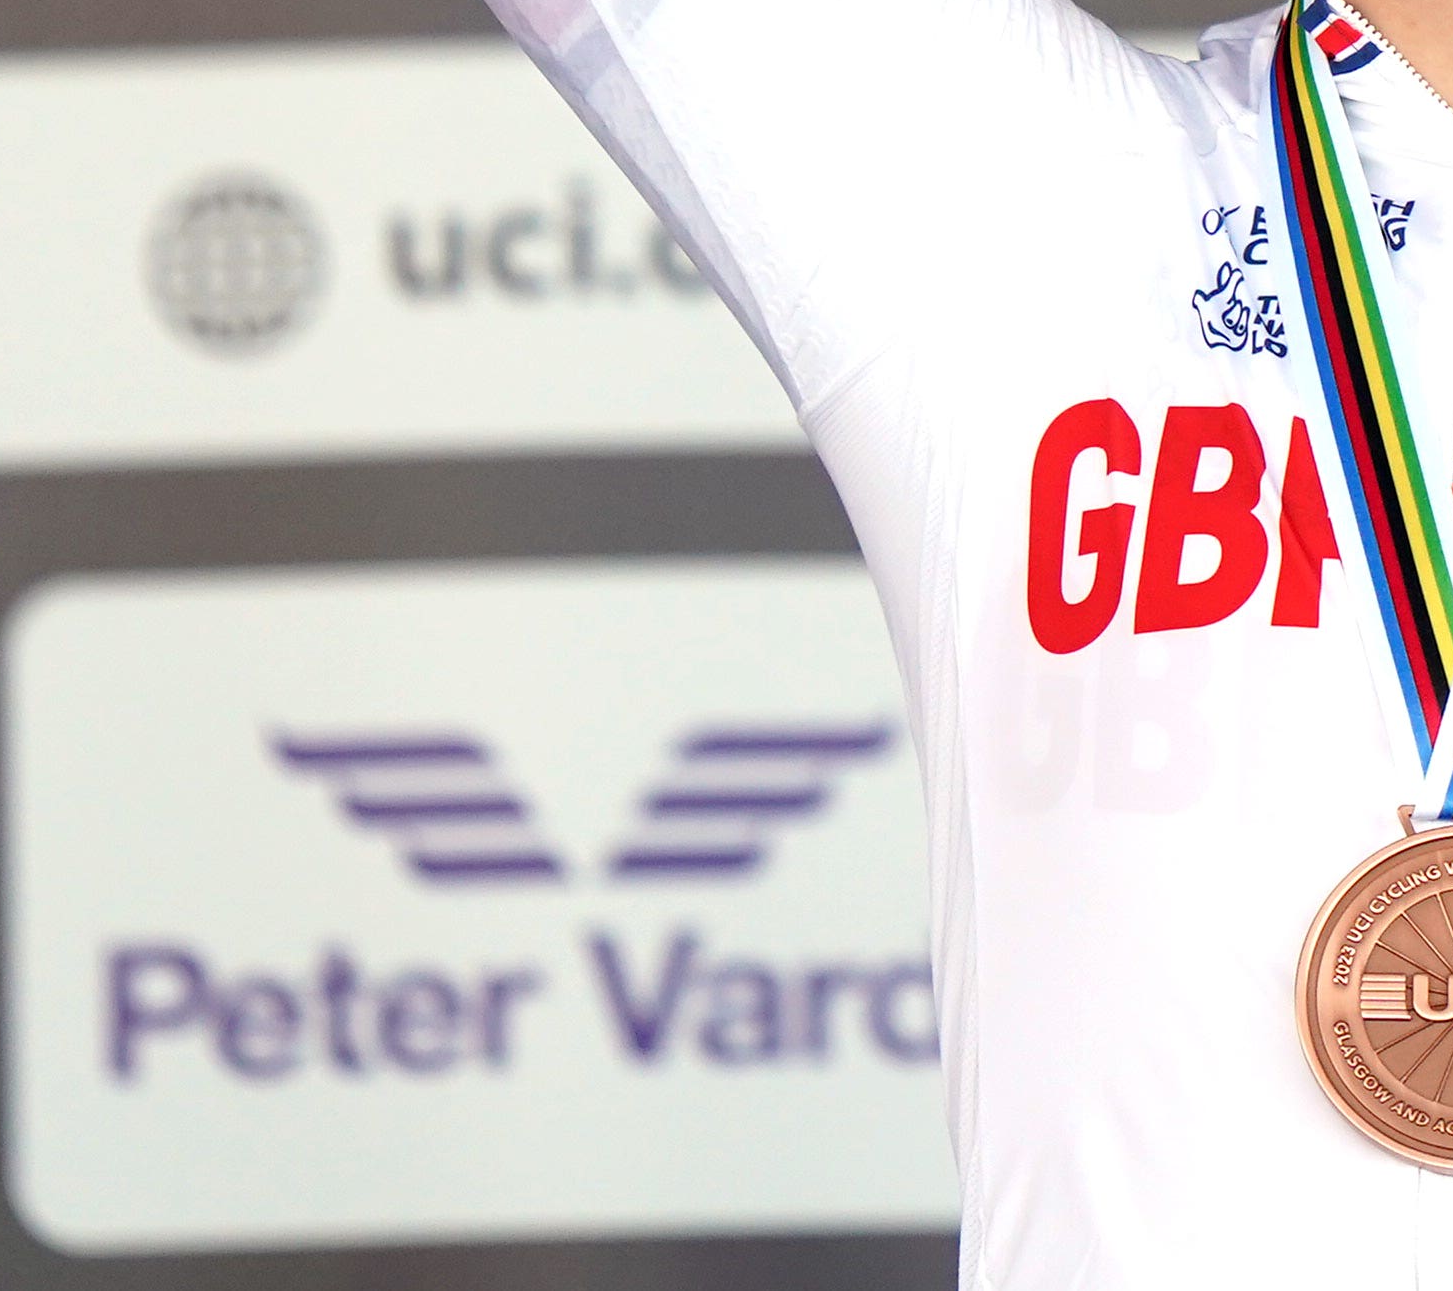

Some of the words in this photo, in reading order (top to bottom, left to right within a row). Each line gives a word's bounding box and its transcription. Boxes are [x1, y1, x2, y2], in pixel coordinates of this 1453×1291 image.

[1333, 943, 1357, 987] 2023
[1347, 912, 1375, 943] UCI
[1368, 863, 1443, 915] CYCLING
[103, 938, 543, 1088] Peter
[1333, 1021, 1394, 1105] GLASGOW
[1390, 1100, 1431, 1128] AND
